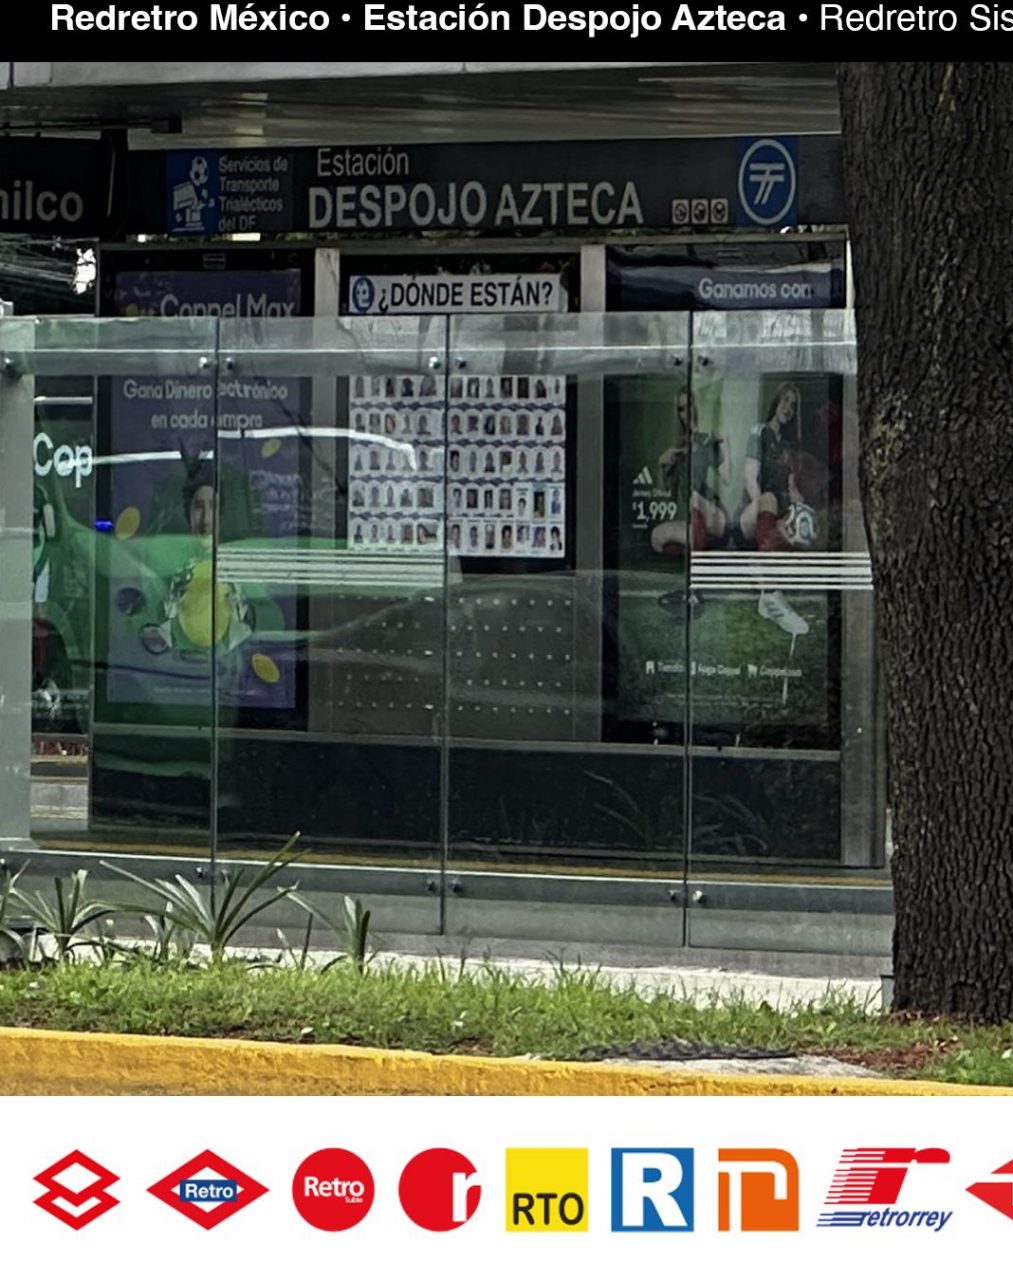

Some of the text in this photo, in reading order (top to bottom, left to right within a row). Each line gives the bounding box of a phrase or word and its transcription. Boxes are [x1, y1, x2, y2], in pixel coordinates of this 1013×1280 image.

[218, 155, 288, 173] Servicios de
[316, 147, 410, 177] Estación
[218, 176, 280, 195] Transporte
[0, 179, 84, 222] ilco
[308, 180, 644, 229] DESPOJO AZTECA
[218, 214, 257, 232] del DF
[378, 275, 554, 311] ¿DÓNDE ESTÁN?
[699, 278, 812, 299] Ganamos con
[246, 294, 295, 317] Max
[123, 379, 163, 399] Gana
[165, 379, 213, 400] Dinero
[151, 413, 167, 429] en
[170, 409, 209, 429] cada
